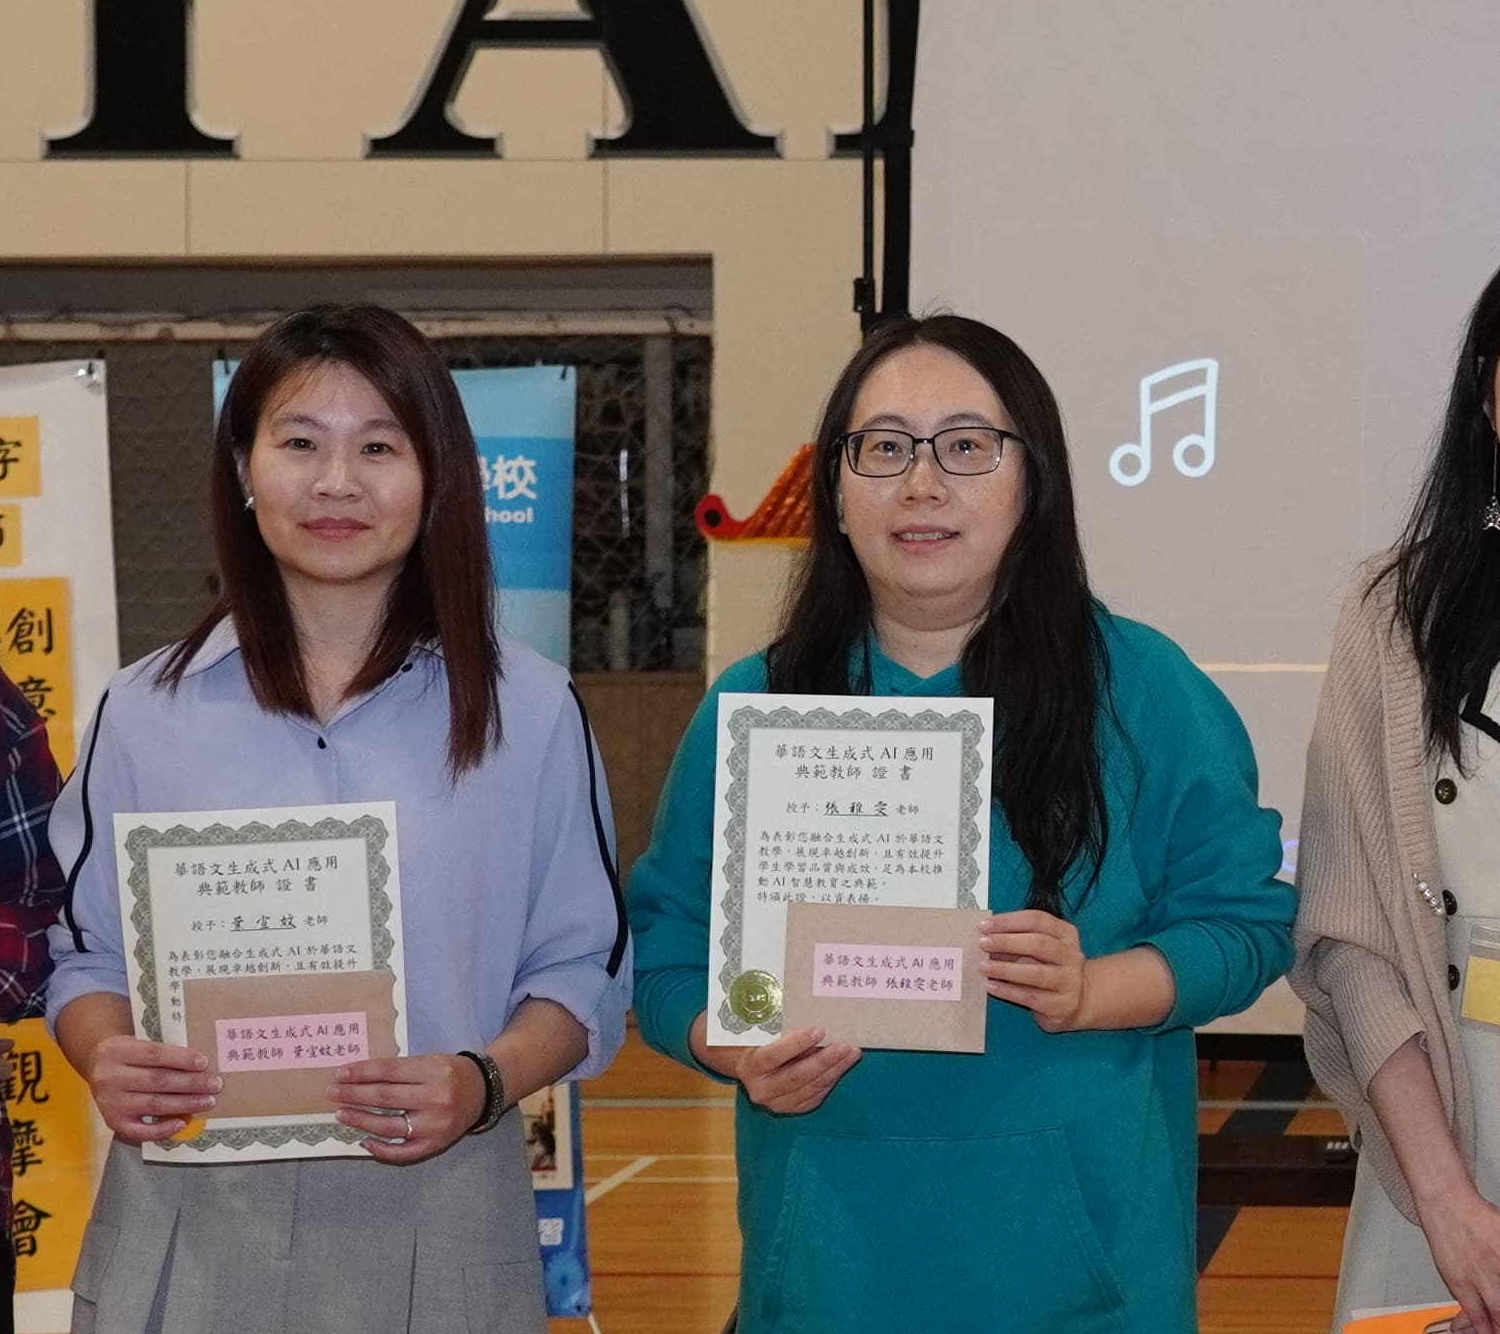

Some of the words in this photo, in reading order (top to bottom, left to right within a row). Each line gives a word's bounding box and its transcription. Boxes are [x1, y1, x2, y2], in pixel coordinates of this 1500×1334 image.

[775, 744, 875, 761] 華語文生成式
[880, 746, 898, 760] AI
[903, 747, 934, 762] 應用
[795, 764, 862, 780] 典範教師
[877, 833, 890, 845] AI
[175, 857, 277, 877] 華語文生成式
[283, 857, 300, 871] AI
[307, 856, 338, 870] 應用
[196, 878, 265, 897] 典範教師
[287, 946, 301, 956] AI
[823, 952, 909, 970] 華語文生成式
[912, 957, 925, 969] AI
[928, 958, 955, 971] 應用
[820, 974, 878, 988] 典範教師
[227, 1026, 312, 1042] 華語文生成式
[317, 1025, 329, 1037] AI
[332, 1022, 360, 1037] 應用
[227, 1046, 284, 1062] 典範教師
